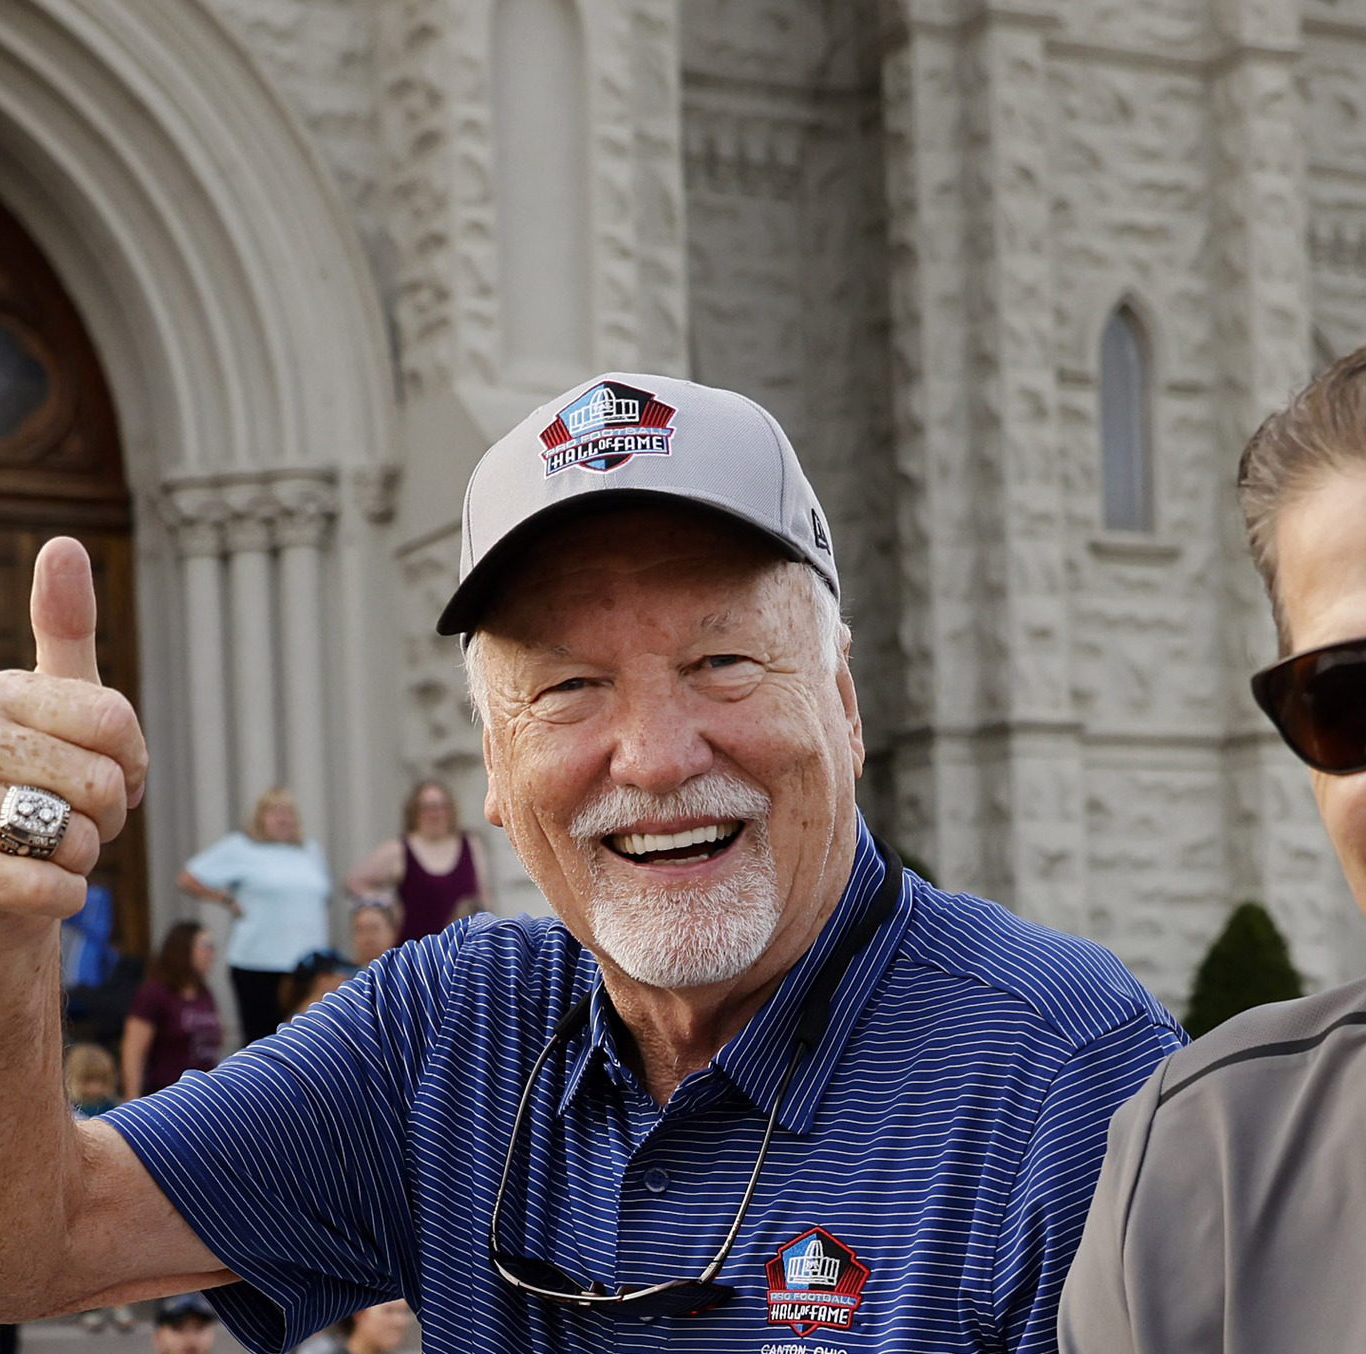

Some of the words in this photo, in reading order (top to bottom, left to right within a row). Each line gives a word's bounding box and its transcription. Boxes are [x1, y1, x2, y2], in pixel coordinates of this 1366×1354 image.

[546, 440, 577, 458] PRO
[581, 427, 669, 445] FOOTBALL
[551, 442, 598, 469] HALL
[598, 438, 612, 450] OF
[611, 435, 663, 451] FAME
[793, 1293, 855, 1306] FOOTBALL
[771, 1303, 801, 1320] HALL
[800, 1305, 810, 1316] OF
[809, 1305, 850, 1324] FAME
